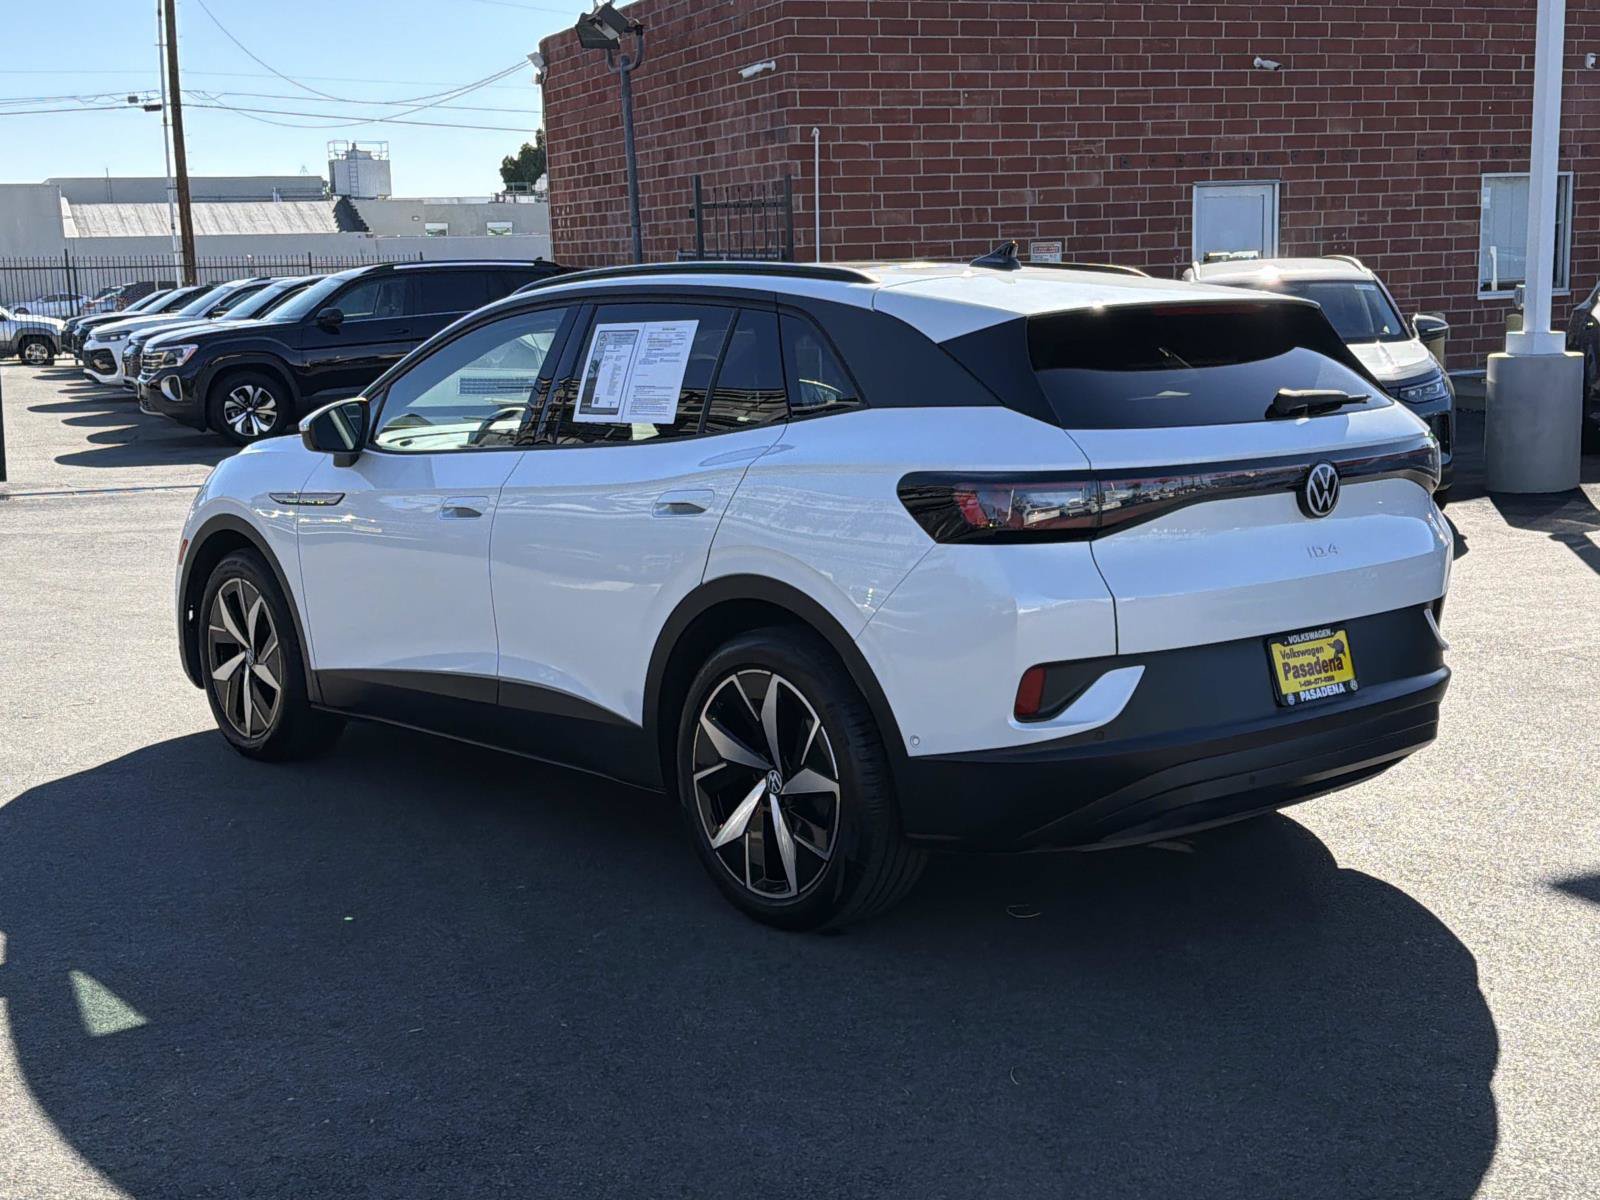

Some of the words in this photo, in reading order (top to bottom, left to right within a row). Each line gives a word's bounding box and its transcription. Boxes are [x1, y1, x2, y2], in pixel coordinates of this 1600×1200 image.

[1288, 628, 1332, 644] VOLKSWAGEN
[1280, 645, 1325, 660] Volkswagen
[1282, 656, 1345, 681] Pasadena
[1299, 683, 1346, 702] PASADENA
